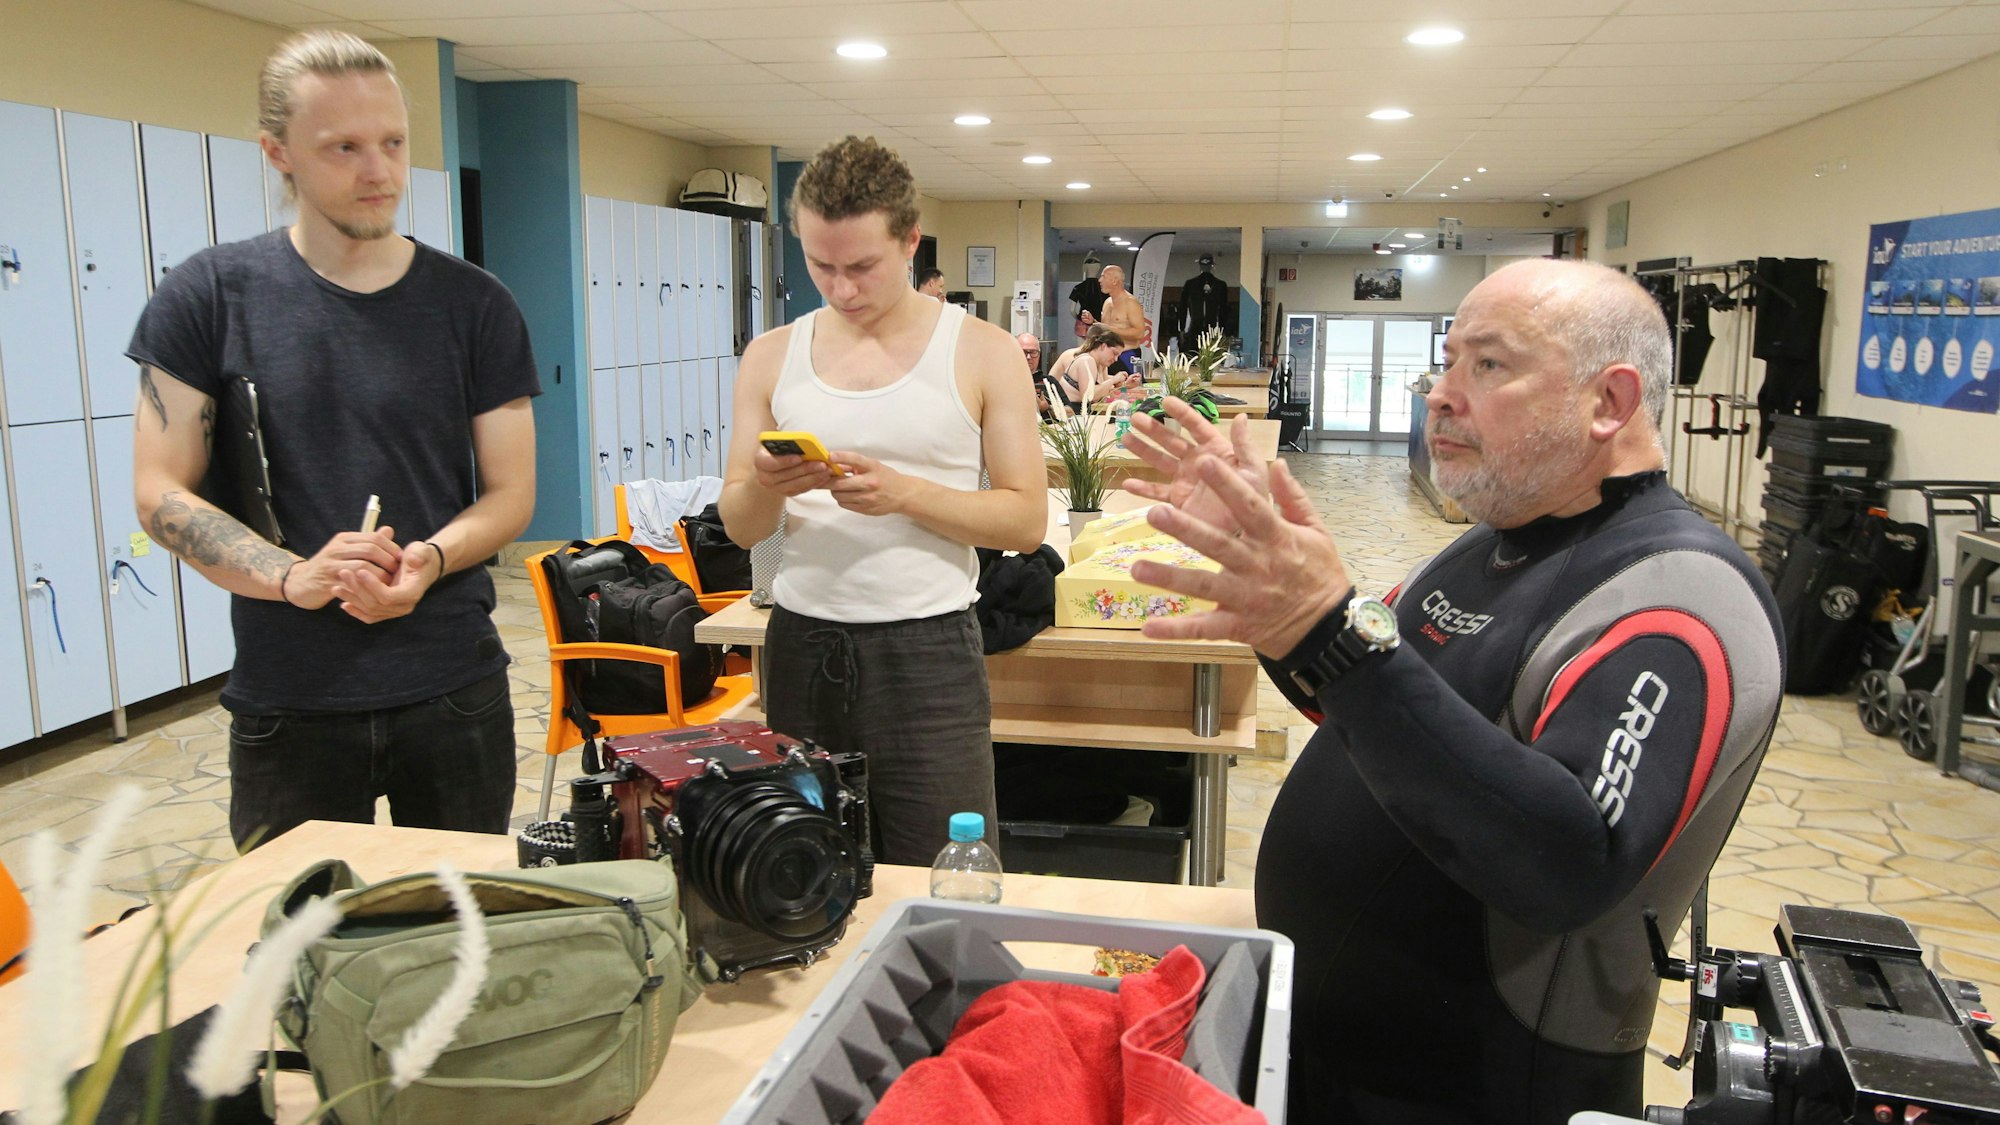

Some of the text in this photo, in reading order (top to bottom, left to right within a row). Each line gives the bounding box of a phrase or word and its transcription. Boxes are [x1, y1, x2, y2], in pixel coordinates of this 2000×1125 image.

[1901, 242, 1928, 258] START
[1928, 239, 1952, 256] YOUR
[1421, 589, 1494, 635] CRESSI
[1591, 670, 1669, 829] CRESS
[473, 968, 554, 1012] VOC
